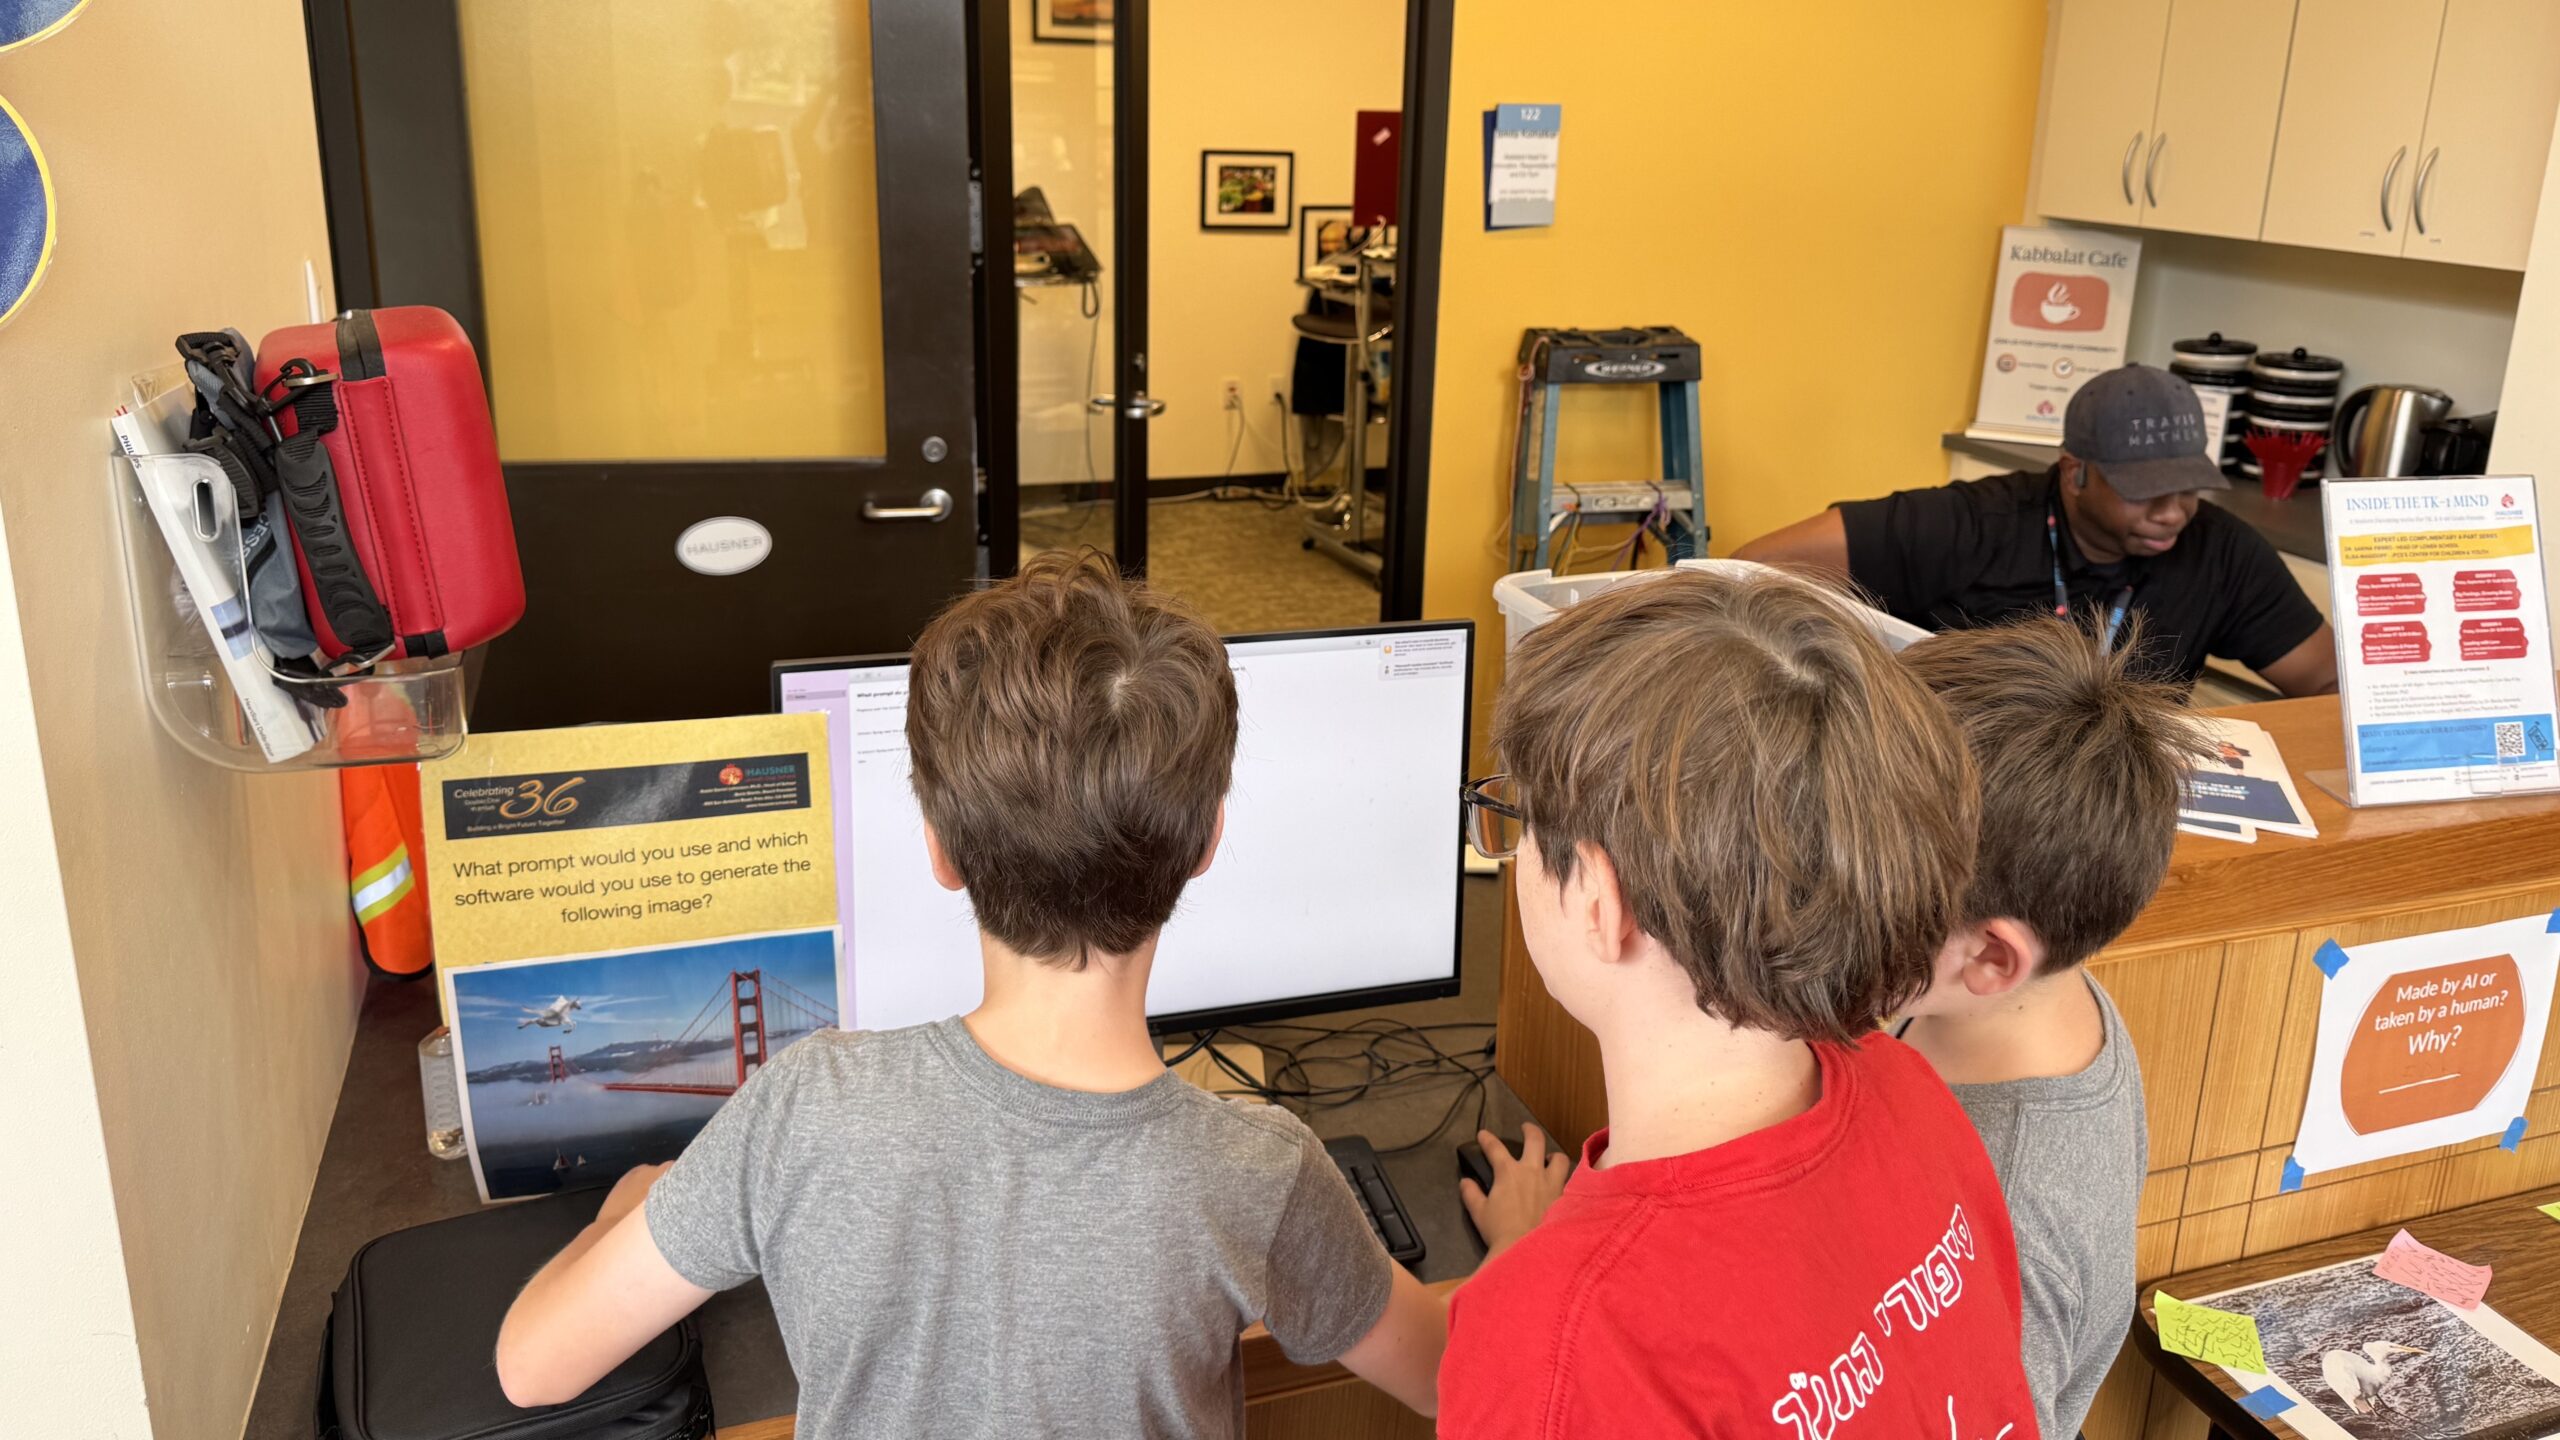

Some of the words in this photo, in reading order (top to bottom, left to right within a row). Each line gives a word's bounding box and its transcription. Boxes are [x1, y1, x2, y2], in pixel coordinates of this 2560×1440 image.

[1520, 107, 1542, 120] 122
[2010, 244, 2085, 265] Kabbalat
[2088, 249, 2128, 269] Cafe
[120, 434, 142, 469] PHILPS
[2345, 497, 2391, 511] INSIDE
[2392, 496, 2420, 510] THE
[2453, 494, 2490, 508] MIND
[686, 535, 763, 556] HAUSNER
[453, 785, 514, 799] Celebrating
[499, 776, 587, 819] 36
[453, 860, 503, 878] What
[508, 854, 575, 877] prompt
[581, 848, 636, 867] would
[641, 847, 674, 865] you
[680, 843, 713, 857] use
[717, 836, 751, 854] and
[757, 831, 808, 849] which
[454, 888, 535, 906] software
[540, 879, 596, 898] would
[600, 878, 634, 896] you
[640, 874, 672, 889] use
[677, 870, 695, 885] to
[700, 862, 779, 886] generate
[784, 858, 811, 873] the
[561, 903, 642, 923] following
[647, 893, 713, 914] image?
[2396, 980, 2439, 1003] Made
[2440, 977, 2461, 996] by
[2461, 972, 2478, 991] AI
[2480, 972, 2498, 987] or
[2374, 1010, 2415, 1032] taken
[2417, 1005, 2436, 1024] by
[2437, 1005, 2447, 1018] a
[2450, 989, 2509, 1016] human?
[2408, 1024, 2463, 1056] Why?
